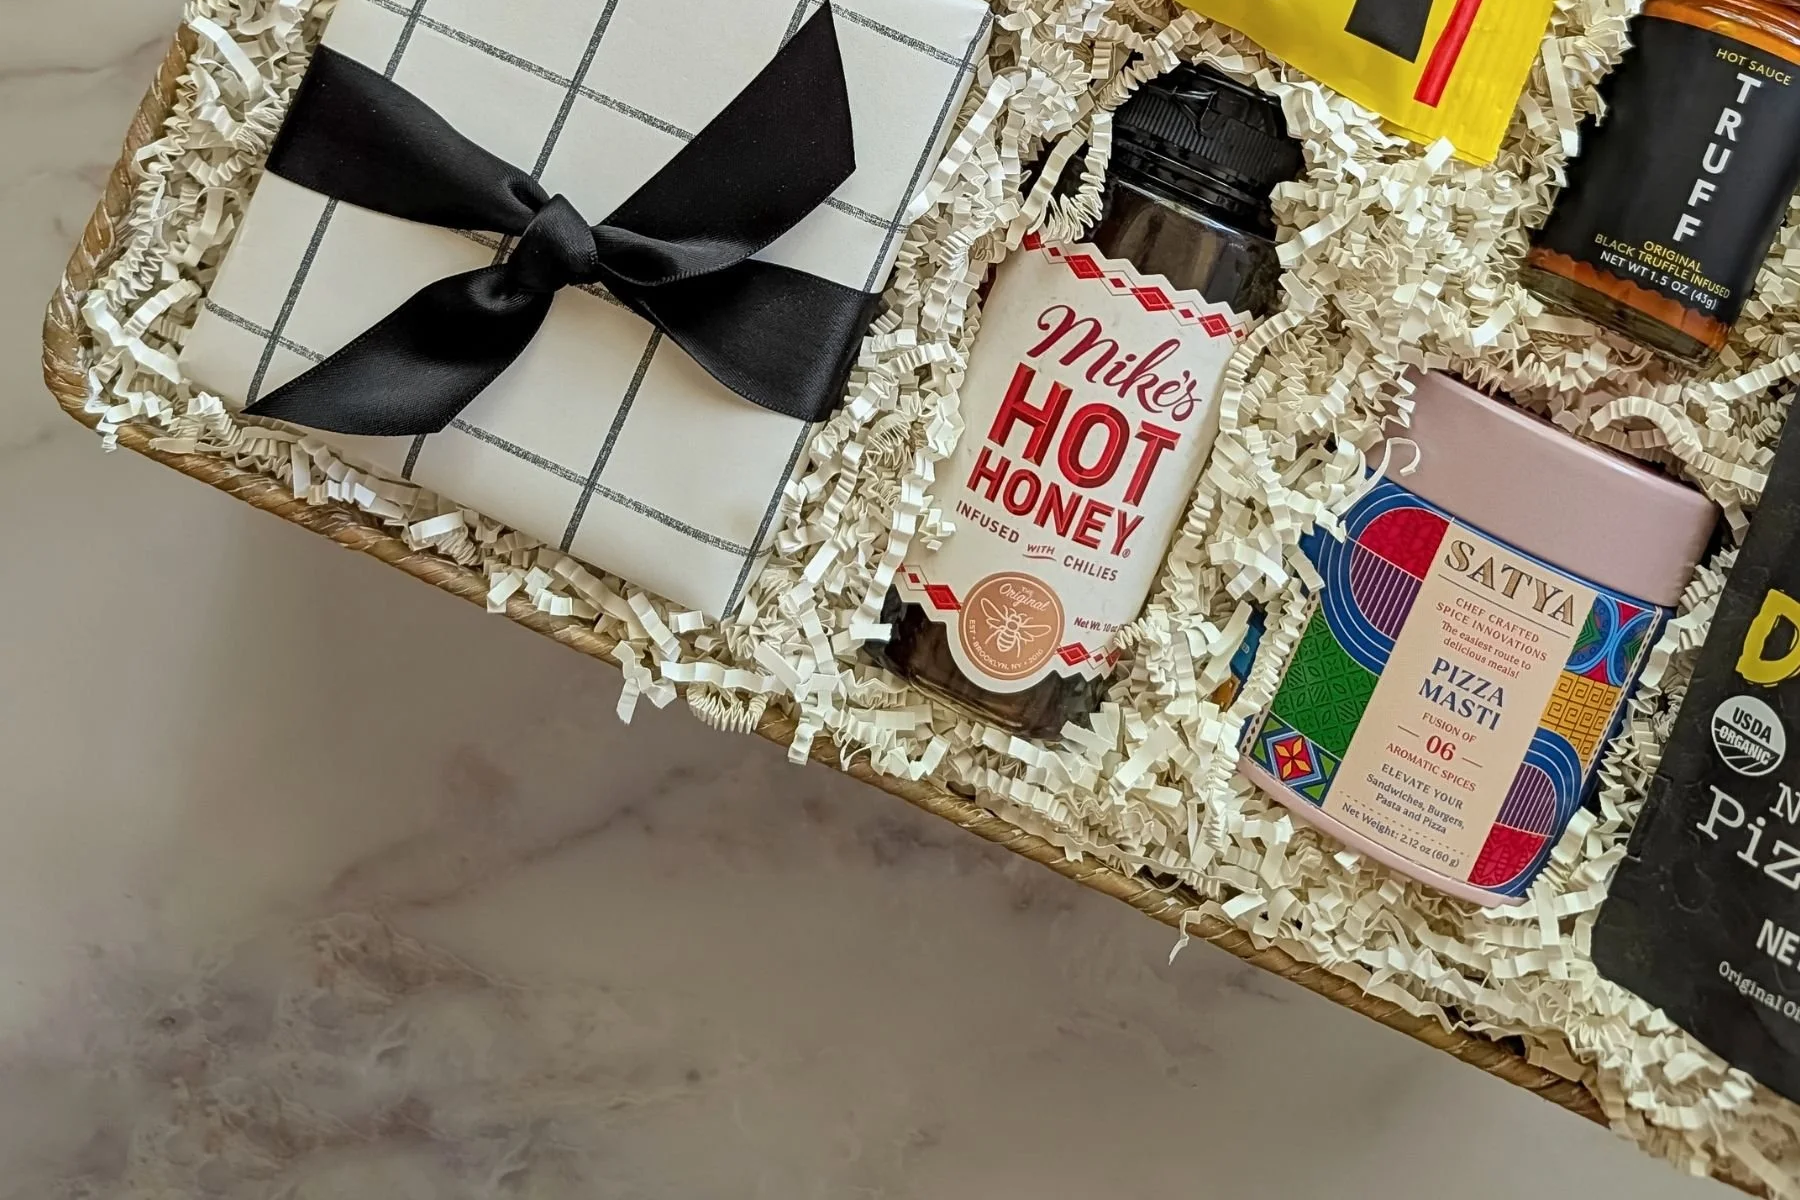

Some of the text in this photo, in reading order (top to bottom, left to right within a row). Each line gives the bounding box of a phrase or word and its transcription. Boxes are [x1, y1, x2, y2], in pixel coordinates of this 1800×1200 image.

[1716, 48, 1792, 86] HOT SAUCE
[1672, 72, 1763, 242] TRUFF
[1594, 233, 1731, 299] BLACK TRUFFLE INFUSED
[1600, 250, 1718, 310] NET WT 1.5 OZ (43g)
[1643, 241, 1702, 274] ORIGINAL
[1026, 304, 1203, 422] Mike's
[987, 362, 1182, 508] HOT
[955, 500, 1119, 582] INFUSED WITH CHILIES
[999, 583, 1051, 612] Original
[1444, 539, 1574, 627] SATYA
[1073, 616, 1089, 629] Net
[1436, 601, 1548, 662] SPICE INNOVATIONS
[1441, 620, 1531, 670] The easiest route to
[1455, 597, 1539, 643] CHEF CRAFTED
[1431, 657, 1504, 708] PIZZA
[1443, 637, 1520, 679] delicious meals!
[1418, 678, 1501, 731] MASTI
[1422, 712, 1477, 743] FUSION OF
[1732, 706, 1772, 744] USDA
[1385, 742, 1477, 792] AROMATIC SPICES
[1426, 735, 1457, 761] 06
[1719, 725, 1771, 765] ORGANIC
[1366, 773, 1465, 830] Sandwiches, Burgers,
[1381, 763, 1464, 810] ELEVATE YOUR
[1342, 802, 1360, 818] Net
[1361, 812, 1399, 839] Weight:
[1399, 833, 1419, 849] 2.12
[1419, 843, 1432, 855] oz
[1375, 792, 1447, 834] Pasta and Pizza
[1756, 918, 1800, 972] NE
[1719, 960, 1784, 1012] Original
